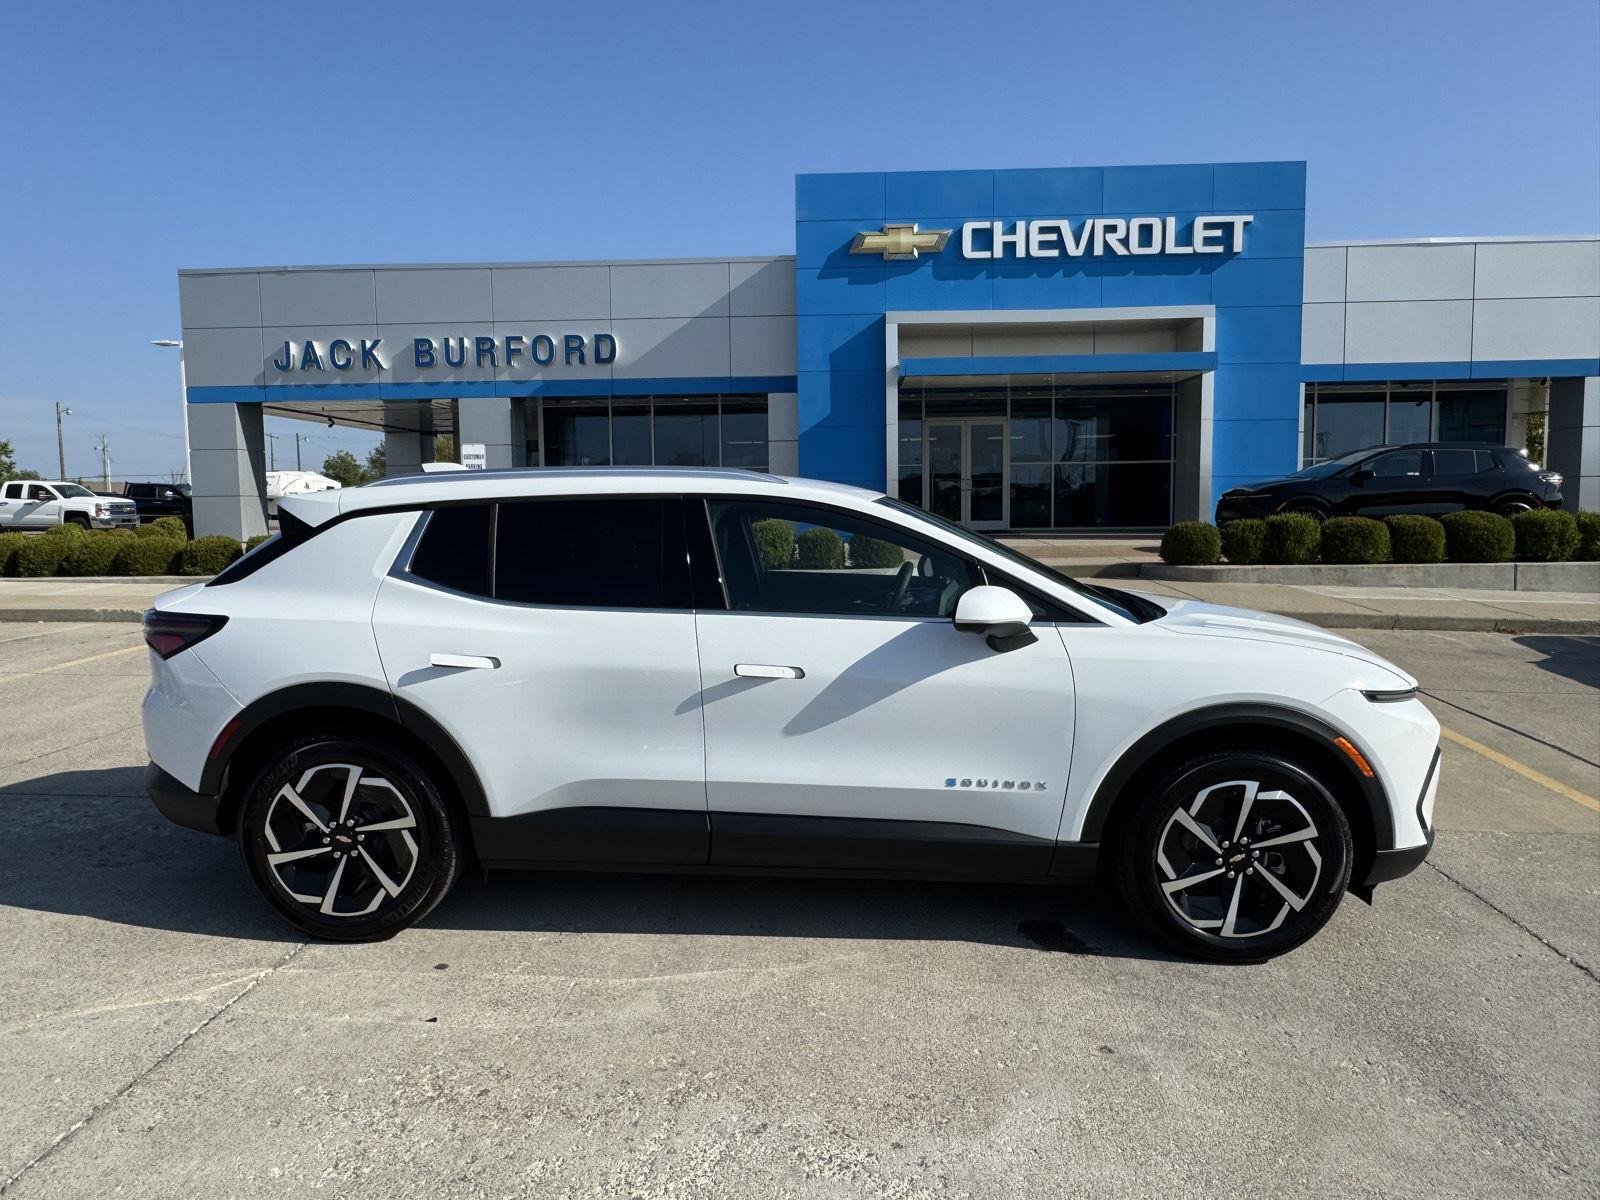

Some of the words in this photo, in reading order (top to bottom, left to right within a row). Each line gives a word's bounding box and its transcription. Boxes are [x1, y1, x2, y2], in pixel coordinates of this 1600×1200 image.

[962, 214, 1254, 259] CHEVROLET
[273, 339, 389, 372] JACK
[413, 333, 618, 368] BURFORD
[944, 777, 1048, 792] EQUINOX
